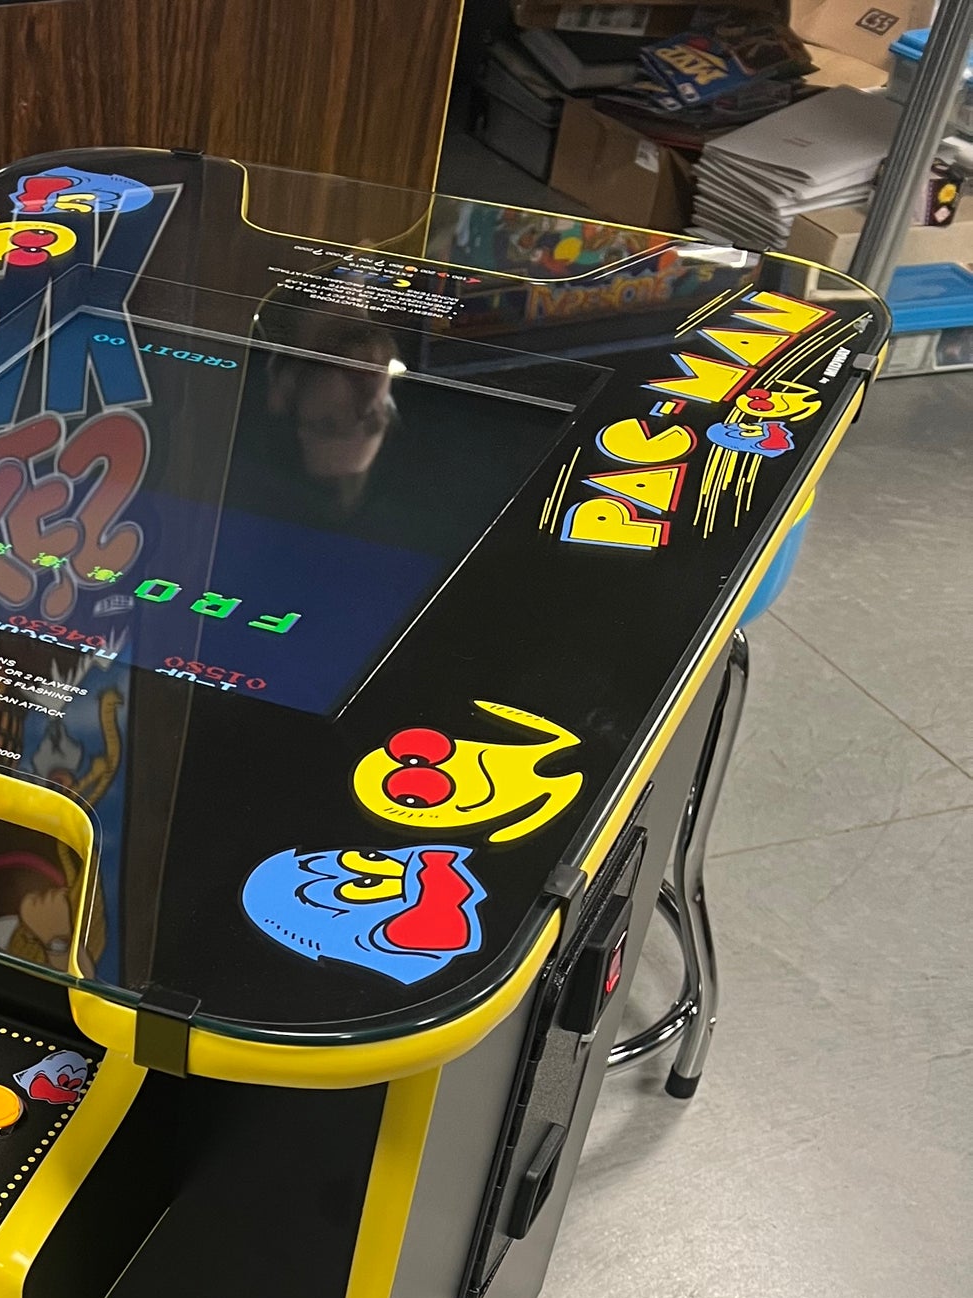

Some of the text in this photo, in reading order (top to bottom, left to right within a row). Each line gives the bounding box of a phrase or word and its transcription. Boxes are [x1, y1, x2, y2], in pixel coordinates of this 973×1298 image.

[93, 334, 238, 369] CREDIT 00
[559, 290, 835, 551] PAC-MAN
[9, 615, 106, 647] 04630
[4, 668, 24, 678] OR
[33, 676, 89, 696] PLAYERS
[14, 681, 74, 703] FLASHING
[18, 700, 67, 719] ATTACK
